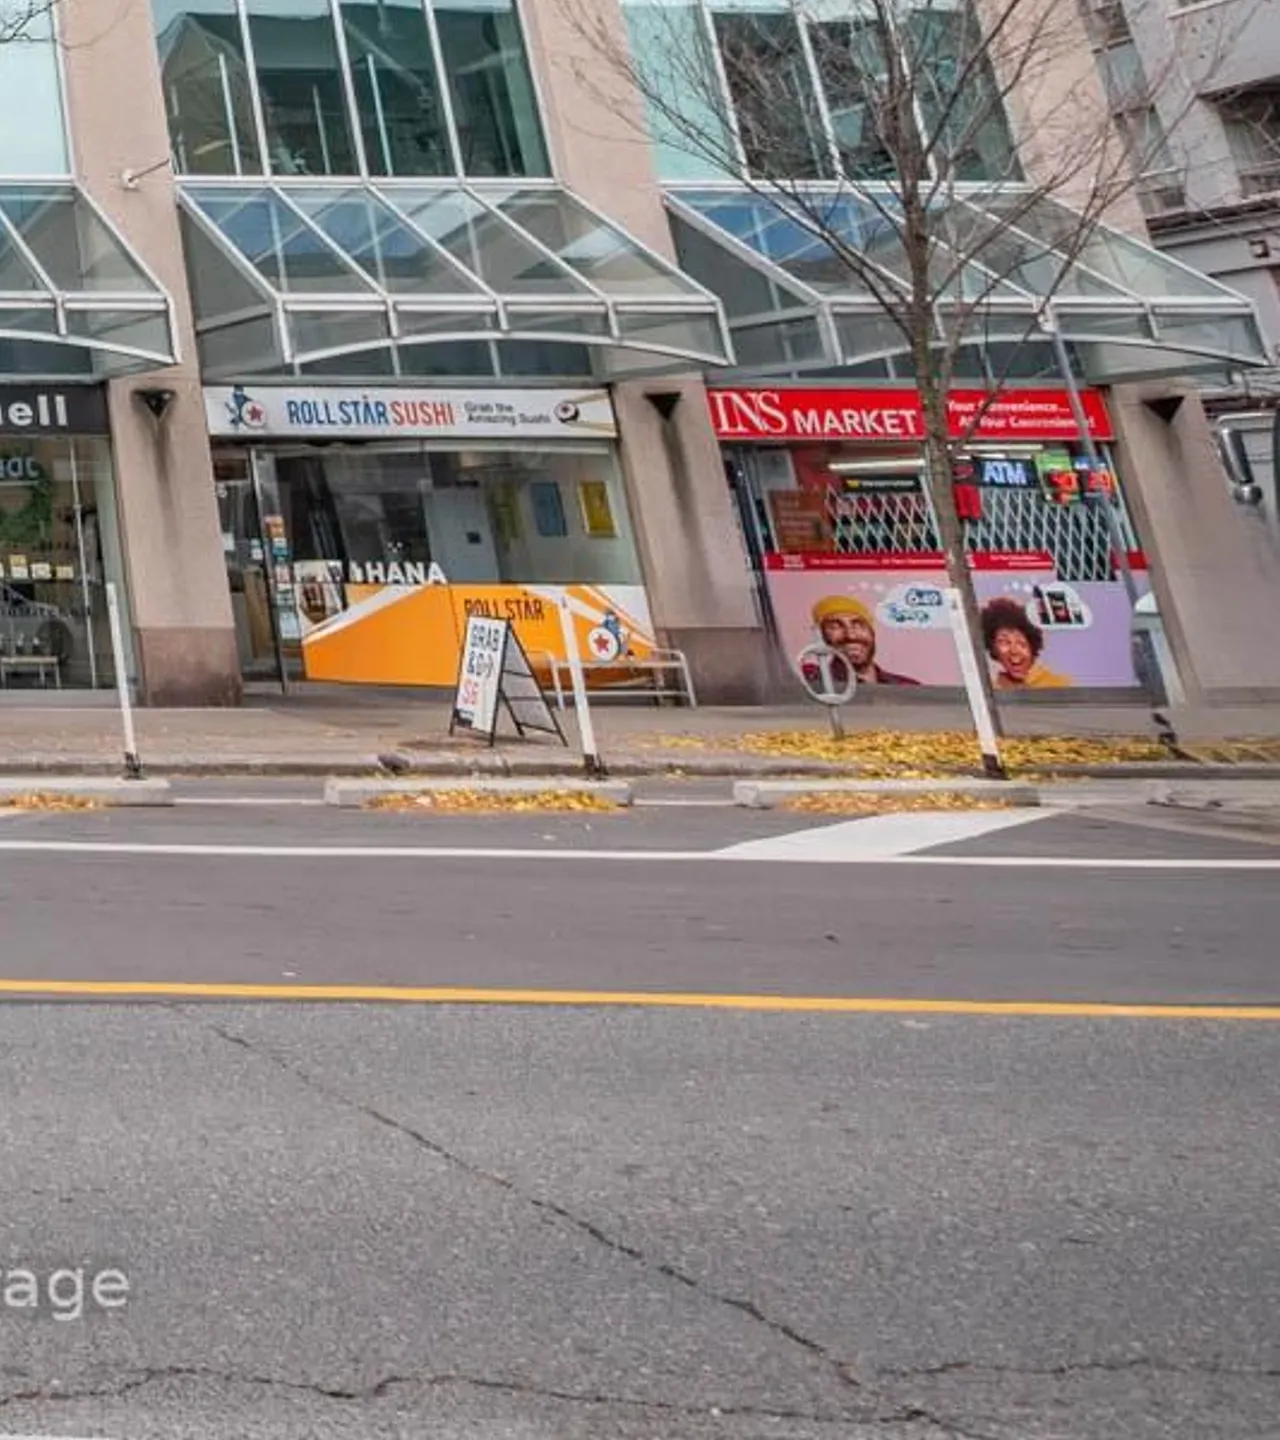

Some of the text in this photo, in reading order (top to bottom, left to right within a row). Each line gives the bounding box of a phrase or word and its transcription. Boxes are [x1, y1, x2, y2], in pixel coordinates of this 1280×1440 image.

[390, 400, 456, 426] SUSHI
[710, 390, 917, 434] INS MARKET
[983, 461, 1027, 485] ATM
